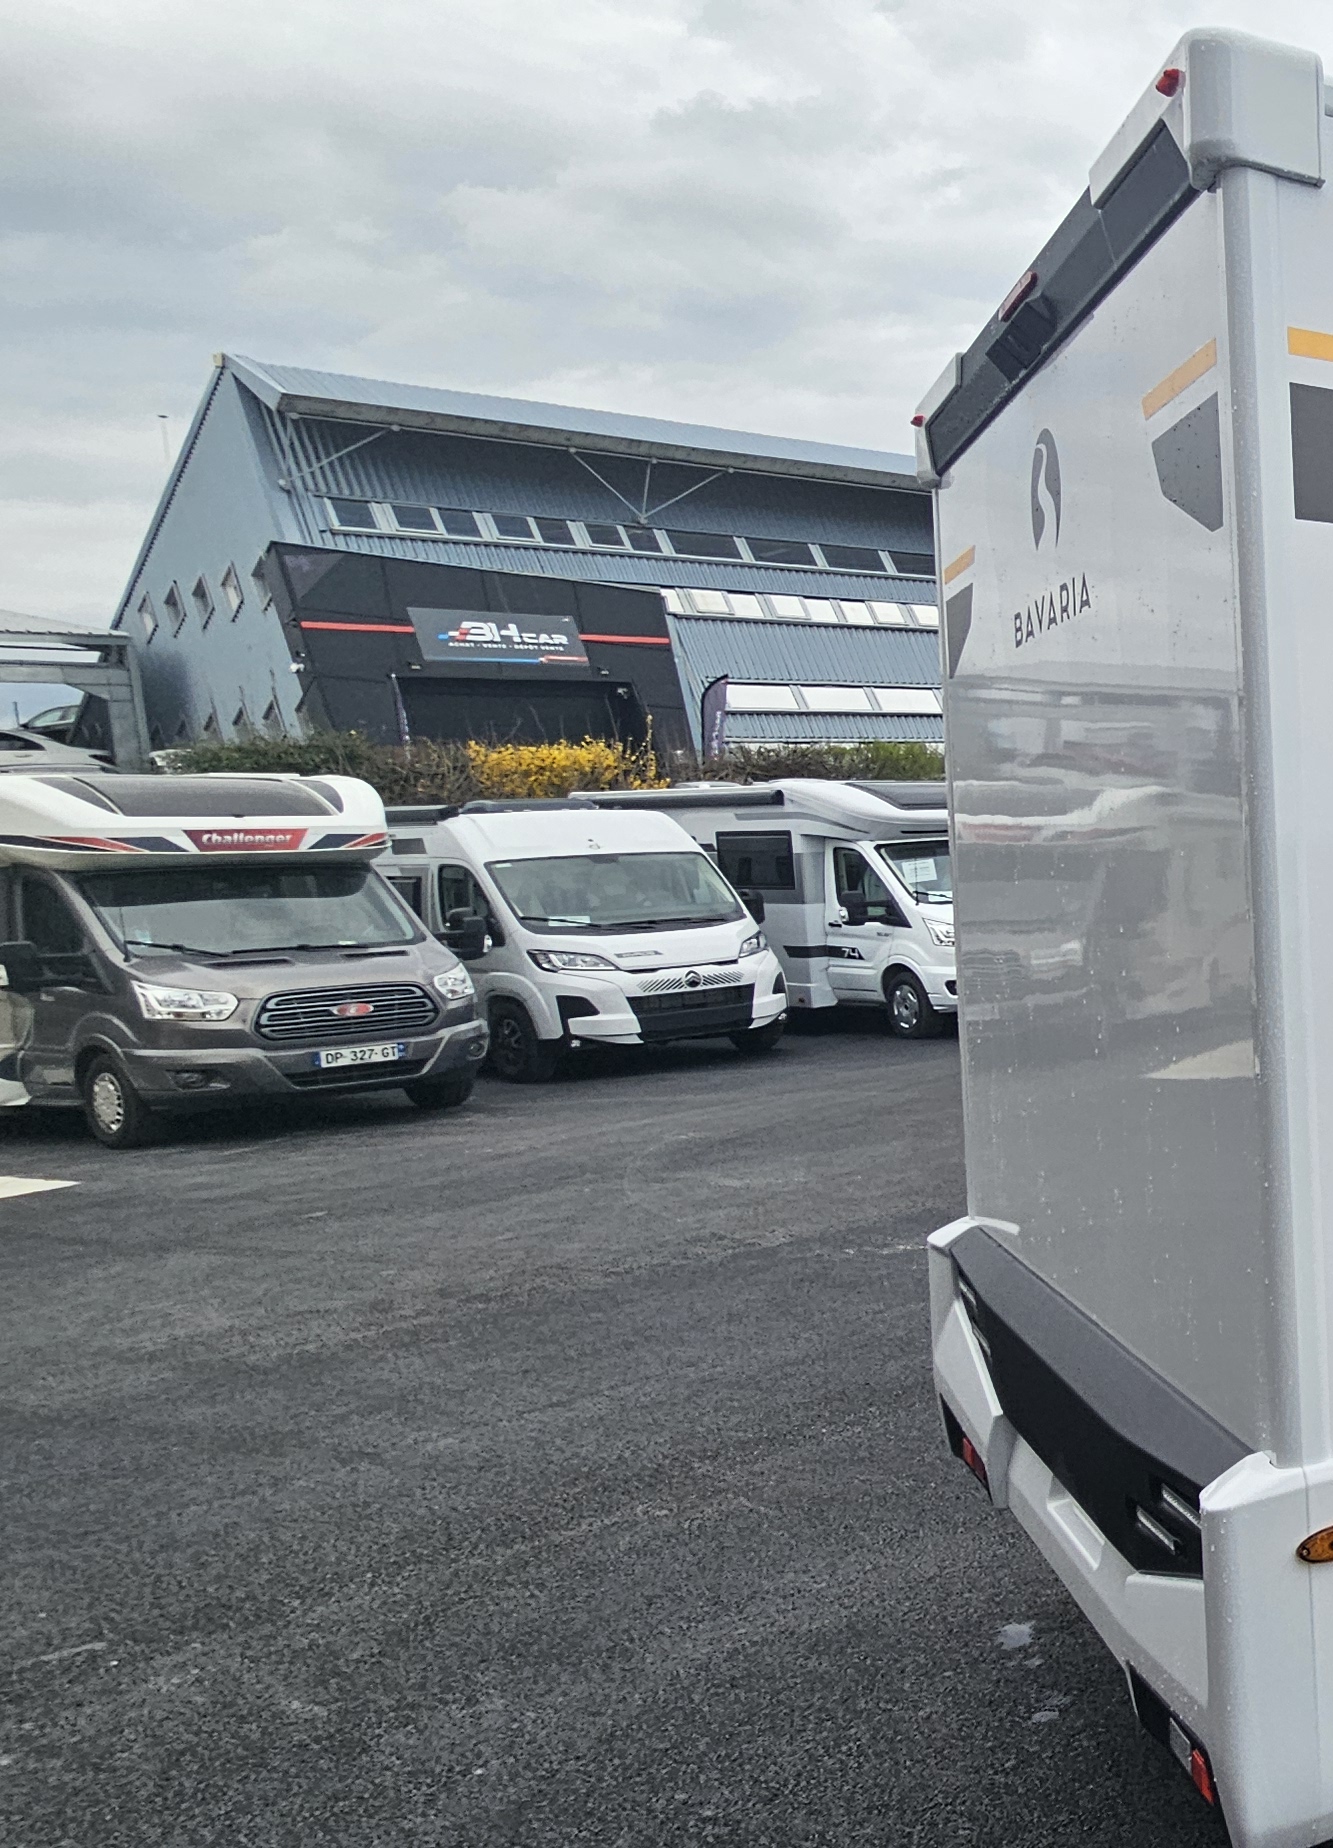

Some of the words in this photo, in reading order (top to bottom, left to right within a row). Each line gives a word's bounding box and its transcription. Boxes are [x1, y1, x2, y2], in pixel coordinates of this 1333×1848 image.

[1014, 572, 1091, 648] BAVARIA
[521, 633, 569, 645] CAR
[201, 832, 293, 844] Challenger
[841, 947, 859, 956] 74
